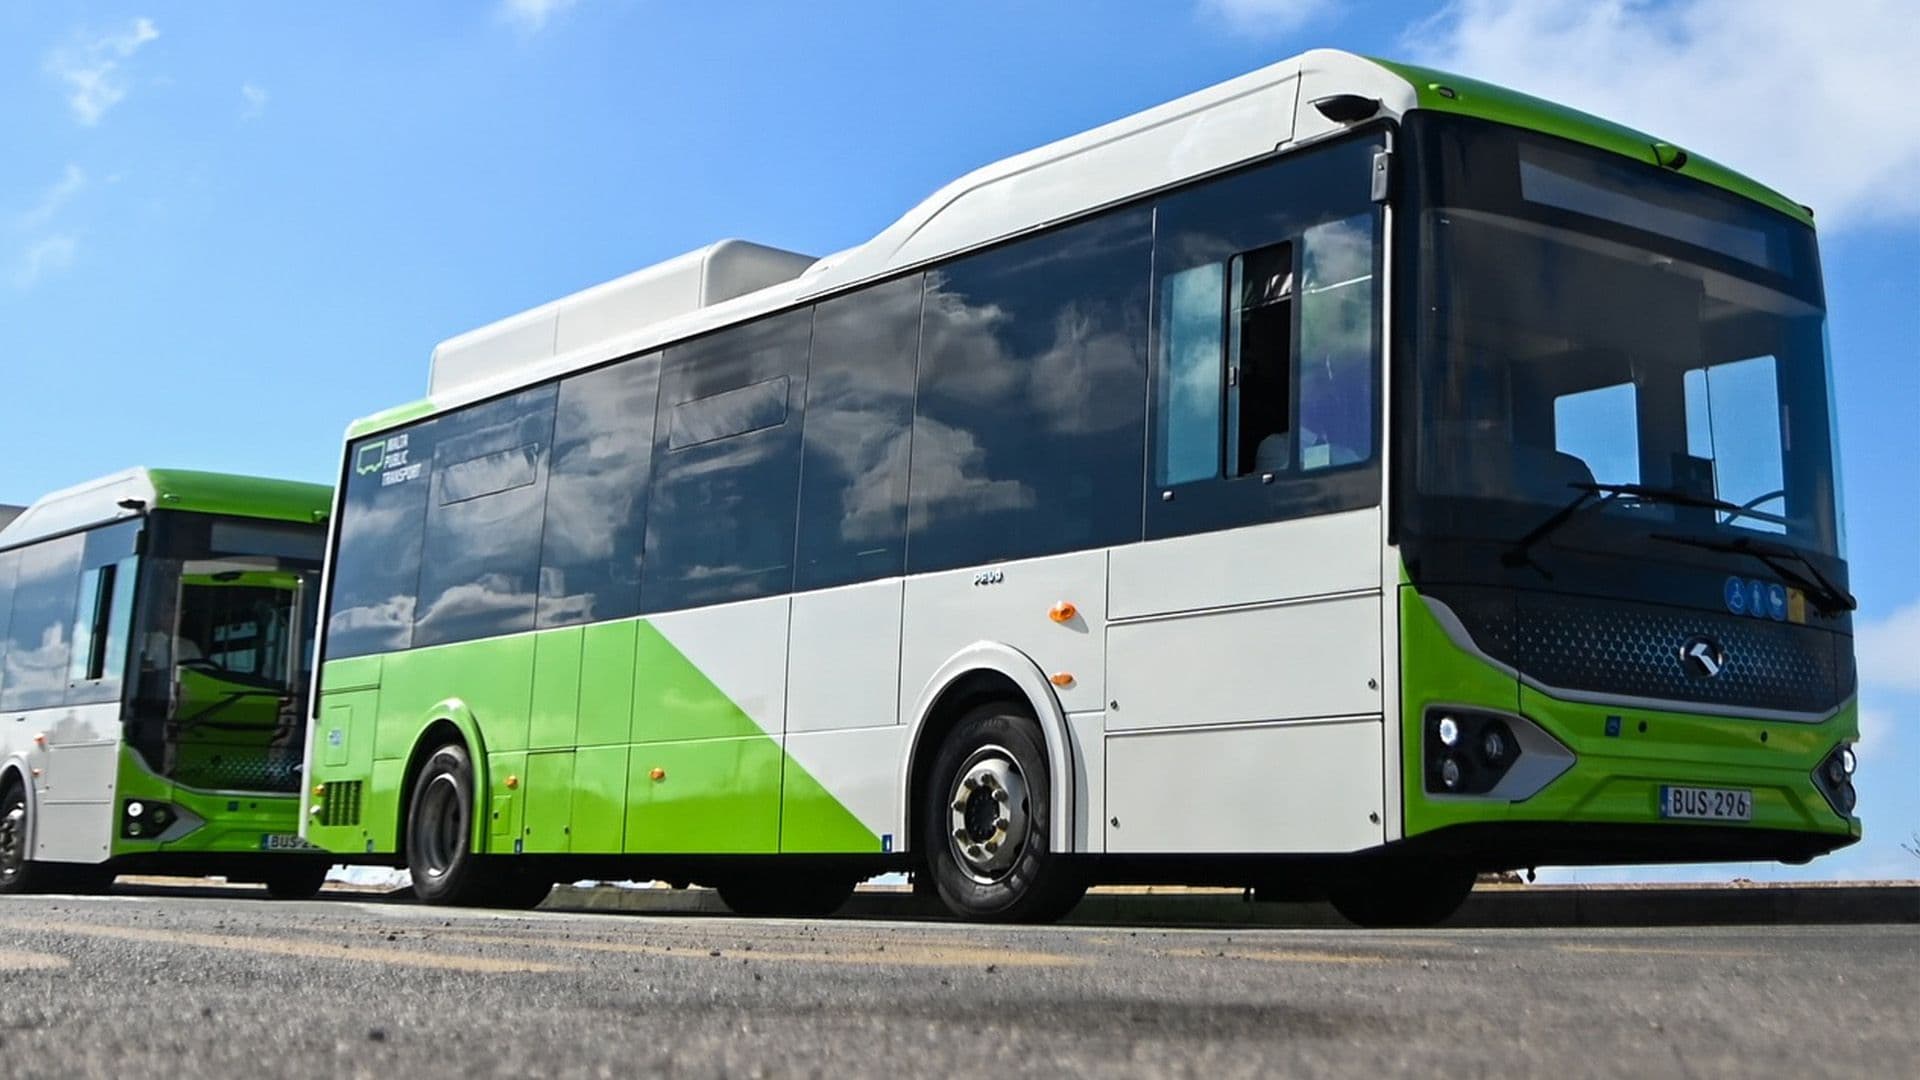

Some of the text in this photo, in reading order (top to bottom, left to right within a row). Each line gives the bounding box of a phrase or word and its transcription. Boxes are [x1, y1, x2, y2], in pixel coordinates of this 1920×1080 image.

[383, 449, 409, 470] PUBLIC
[381, 463, 422, 487] TRANSPORT
[1673, 789, 1746, 817] BUS 296
[271, 835, 297, 848] BUS
